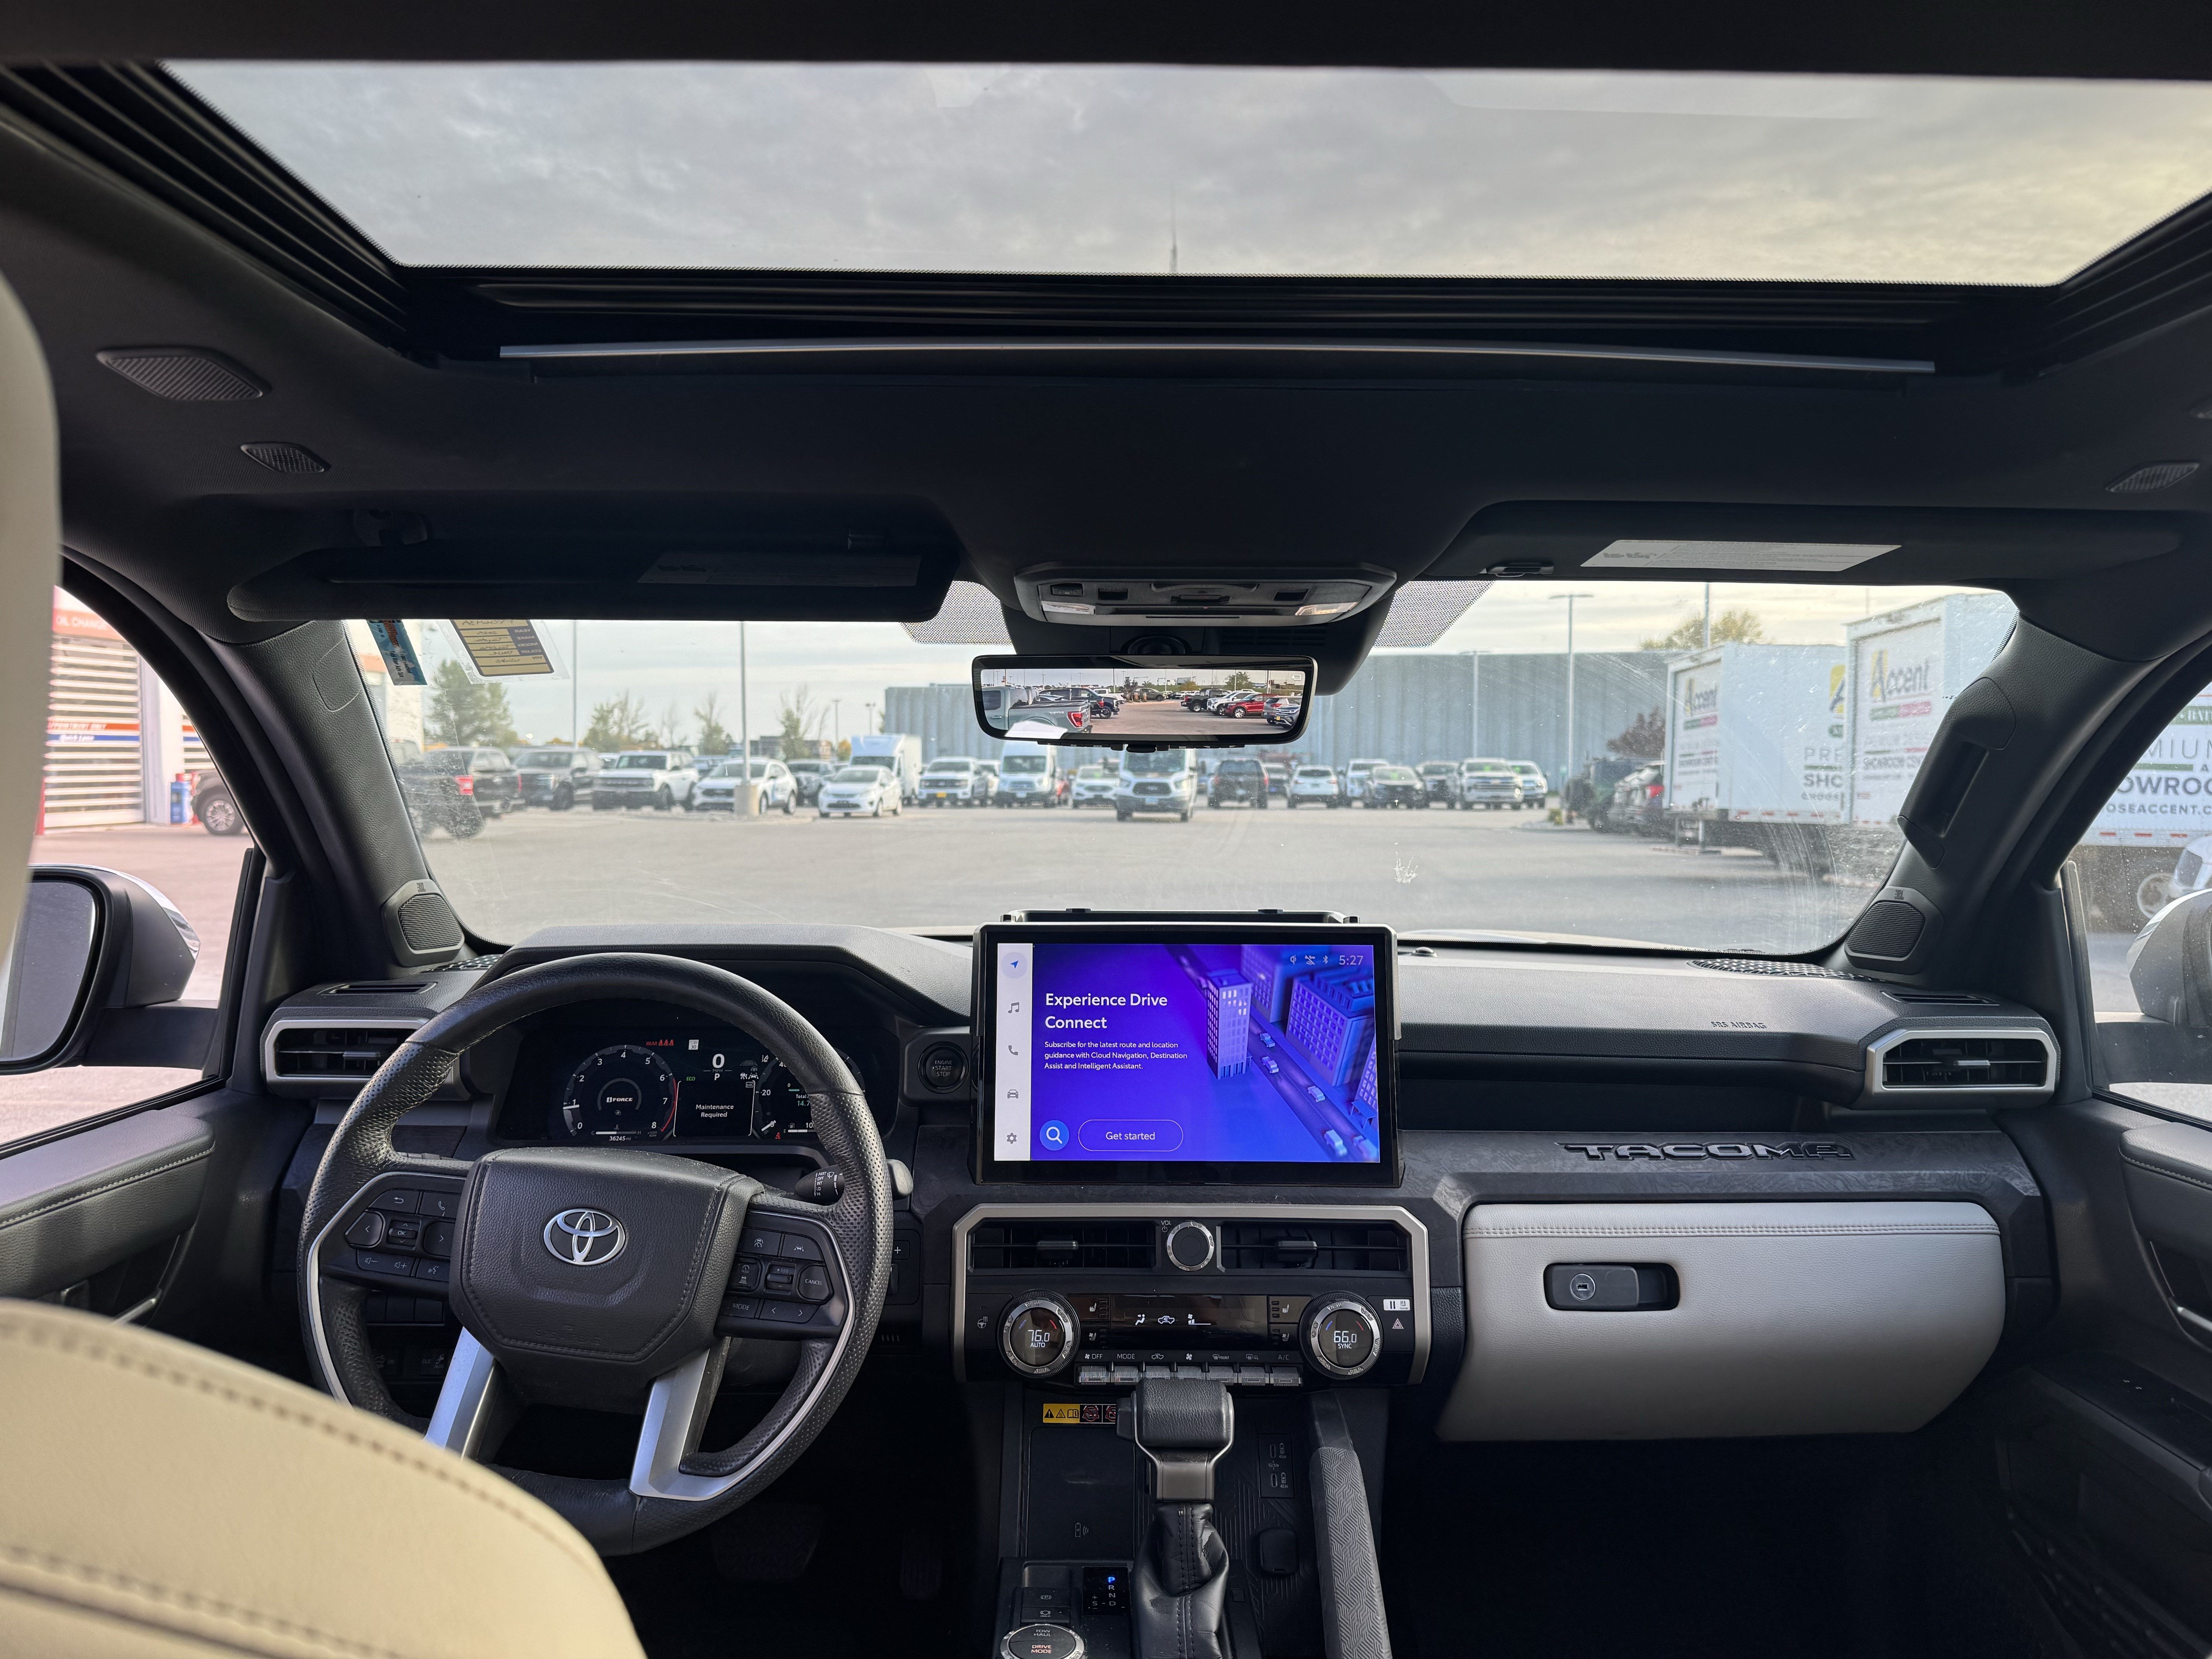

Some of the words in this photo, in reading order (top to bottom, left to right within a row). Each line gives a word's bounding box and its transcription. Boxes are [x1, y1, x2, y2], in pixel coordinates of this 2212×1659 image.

[56, 616, 70, 626] OIL
[1870, 649, 1930, 702] Accent
[417, 882, 426, 893] JBL
[1339, 955, 1364, 965] 5:27
[1046, 993, 1126, 1009] Experience
[1130, 993, 1168, 1006] Drive
[1045, 1016, 1108, 1029] Connect
[712, 1053, 725, 1068] 0
[1555, 1142, 1856, 1161] TACOMA
[1028, 1329, 1050, 1342] 76.0
[1334, 1331, 1357, 1343] 66.0
